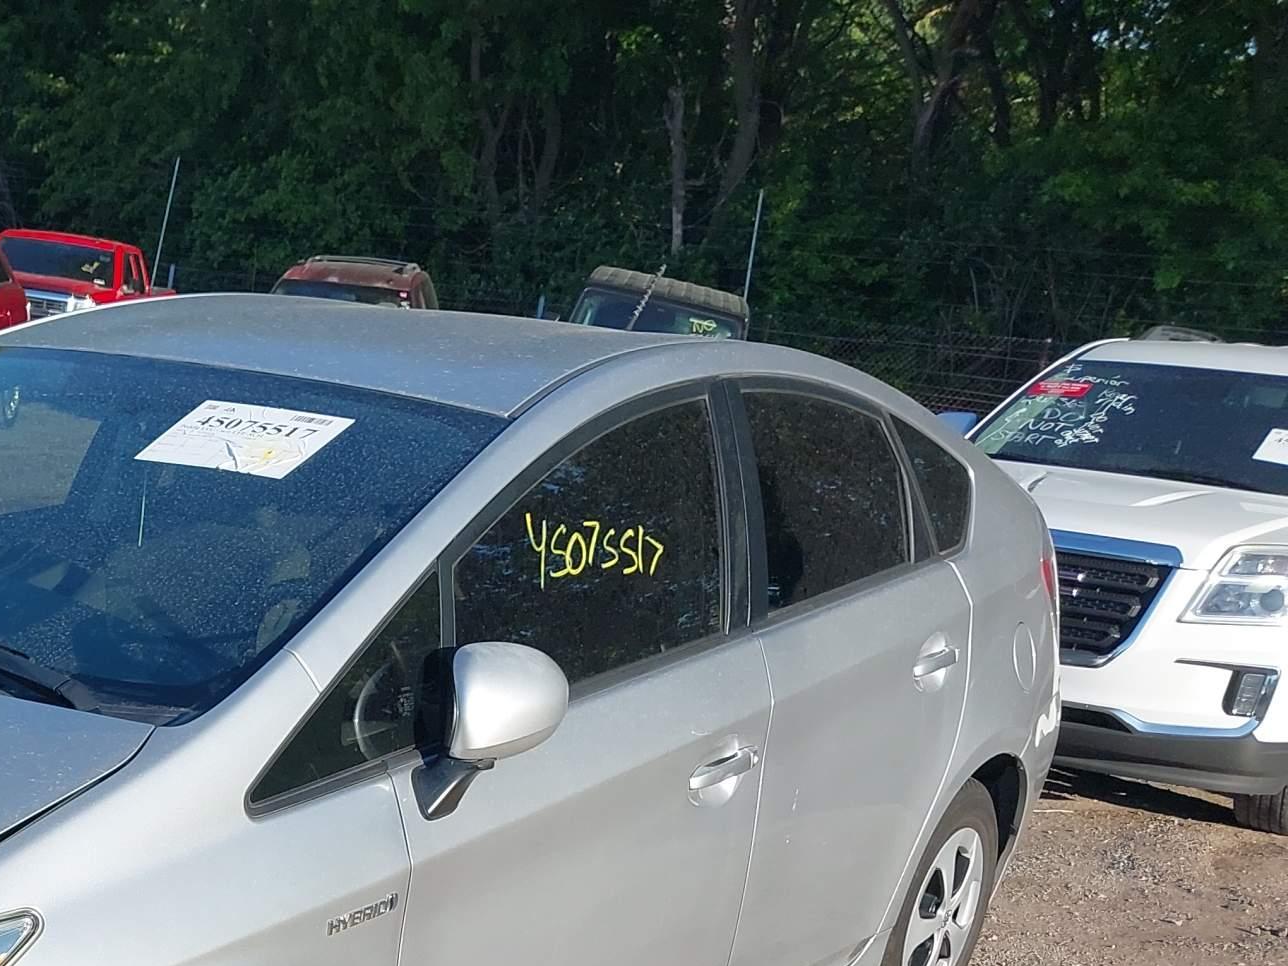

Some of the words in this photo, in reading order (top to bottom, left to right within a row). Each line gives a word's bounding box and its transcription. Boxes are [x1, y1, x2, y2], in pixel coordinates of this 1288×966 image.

[195, 415, 320, 440] 45075517
[1018, 418, 1075, 432] NOT
[525, 512, 665, 592] 45075517
[327, 894, 392, 937] HYBRID
